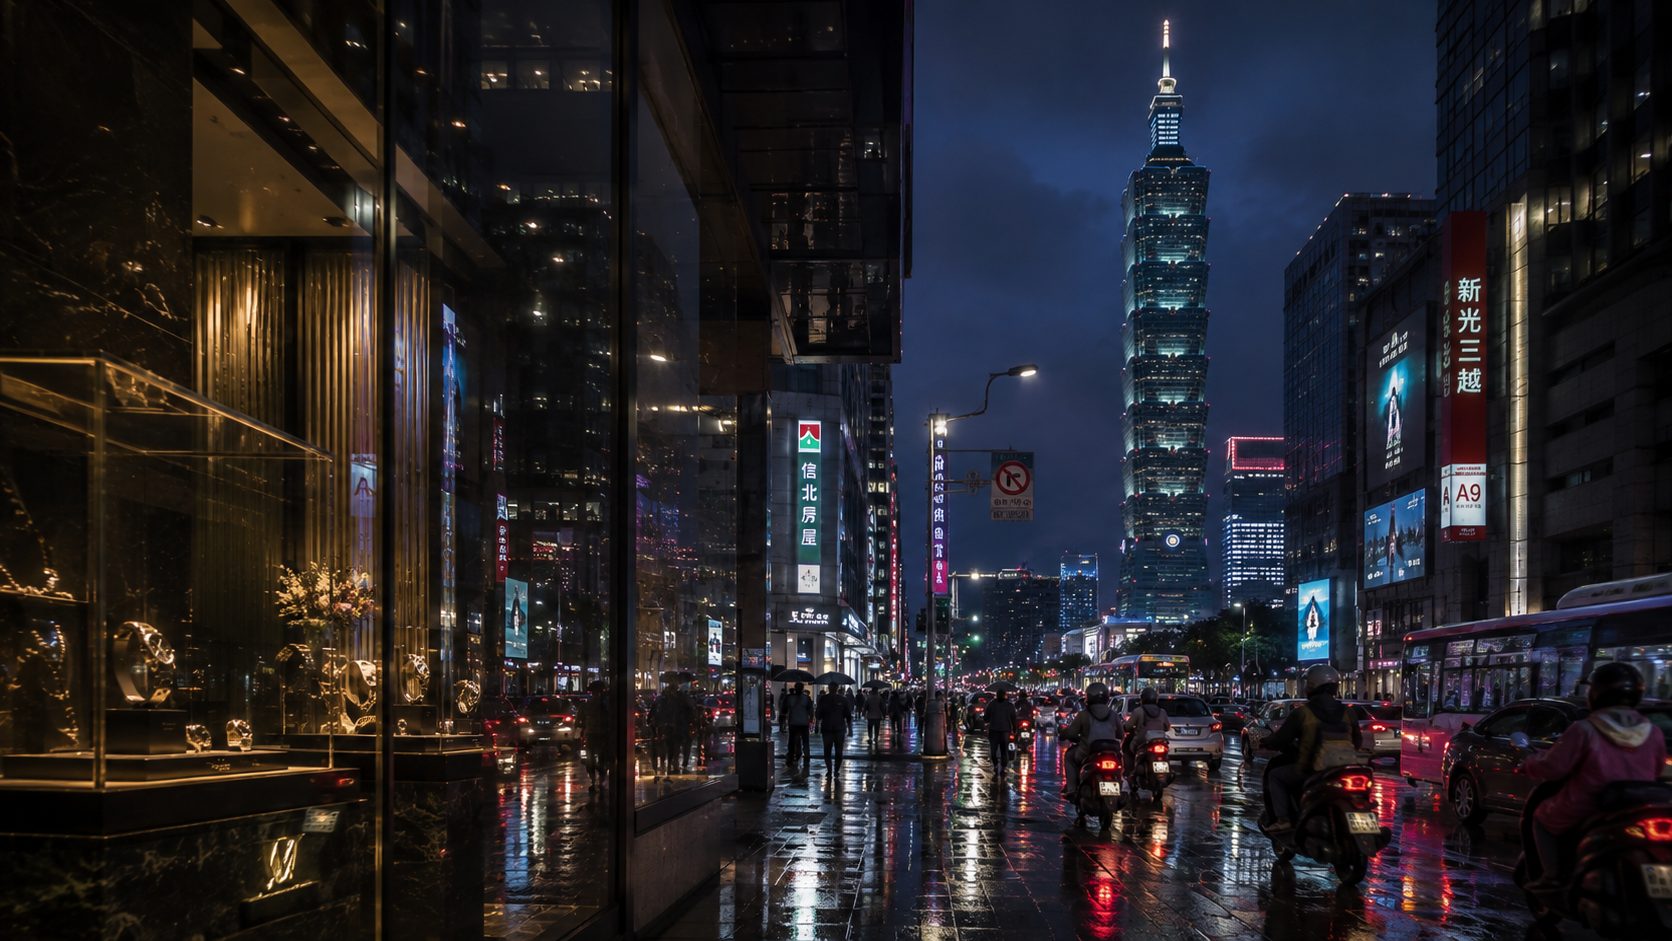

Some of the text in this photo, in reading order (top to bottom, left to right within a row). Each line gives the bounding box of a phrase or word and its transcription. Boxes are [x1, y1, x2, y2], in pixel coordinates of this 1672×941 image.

[1457, 277, 1481, 393] 新光三越
[1456, 483, 1482, 502] A9
